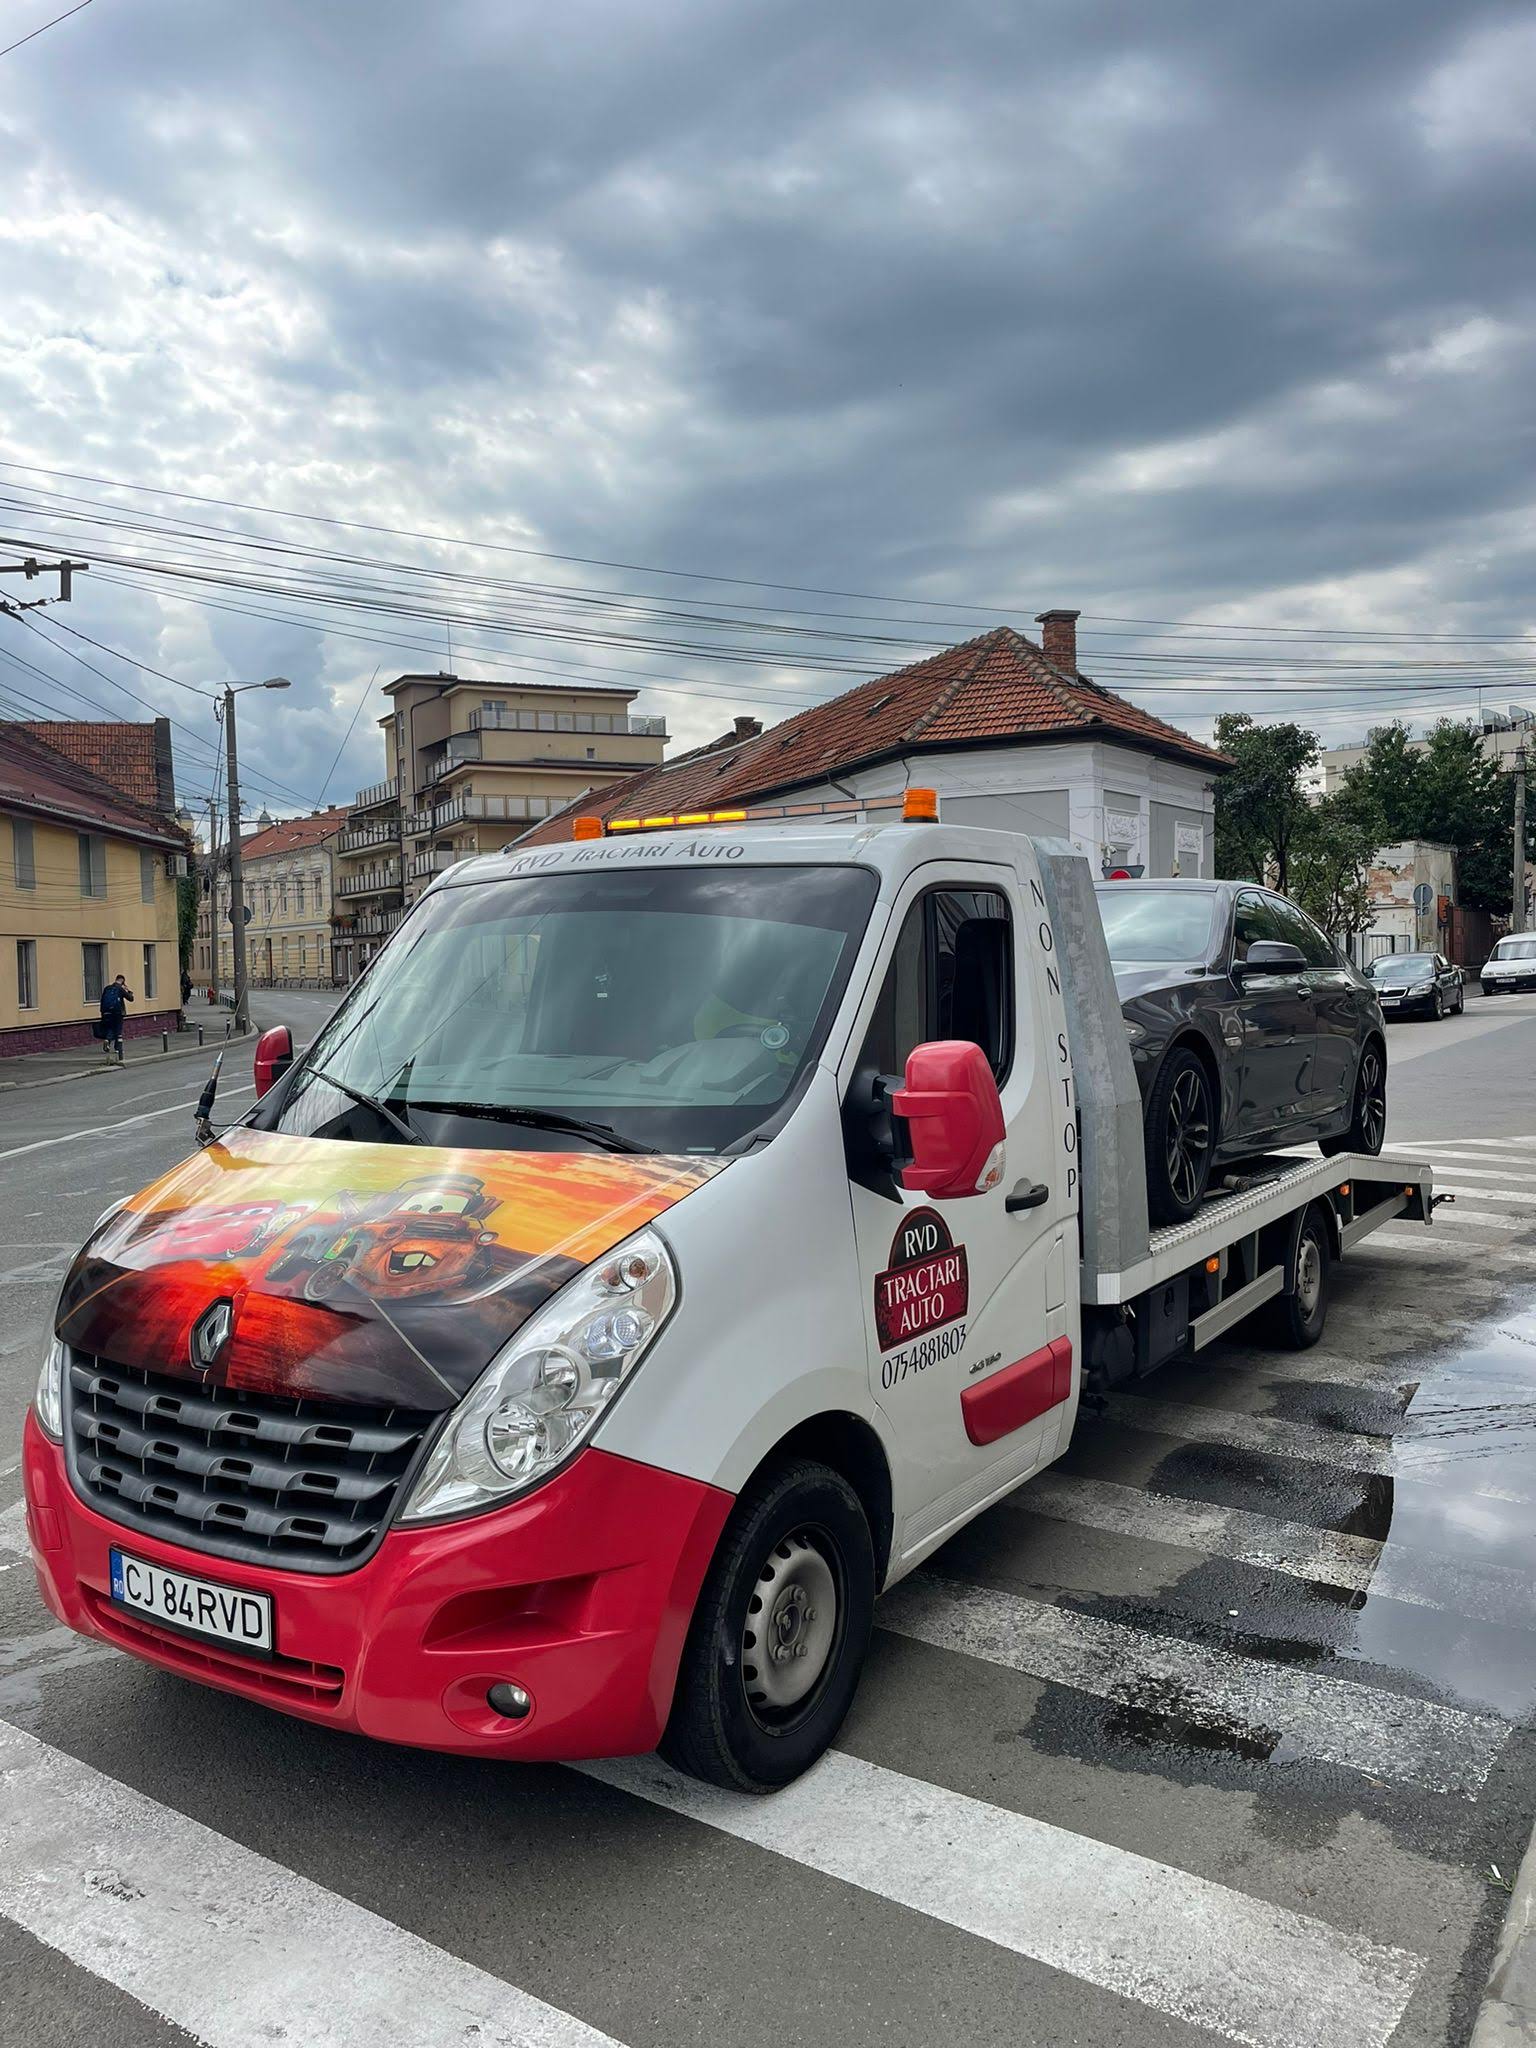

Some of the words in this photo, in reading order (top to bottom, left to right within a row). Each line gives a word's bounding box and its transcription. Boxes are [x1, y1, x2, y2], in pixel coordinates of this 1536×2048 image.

[509, 851, 564, 874] RVD
[675, 841, 745, 859] AUTO
[1058, 1033, 1077, 1198] STOP
[904, 1224, 938, 1258] RVD
[883, 1256, 961, 1308] TRACTARI
[900, 1292, 945, 1334] AUTO
[881, 1324, 967, 1390] 0754881803
[113, 1577, 124, 1595] RO
